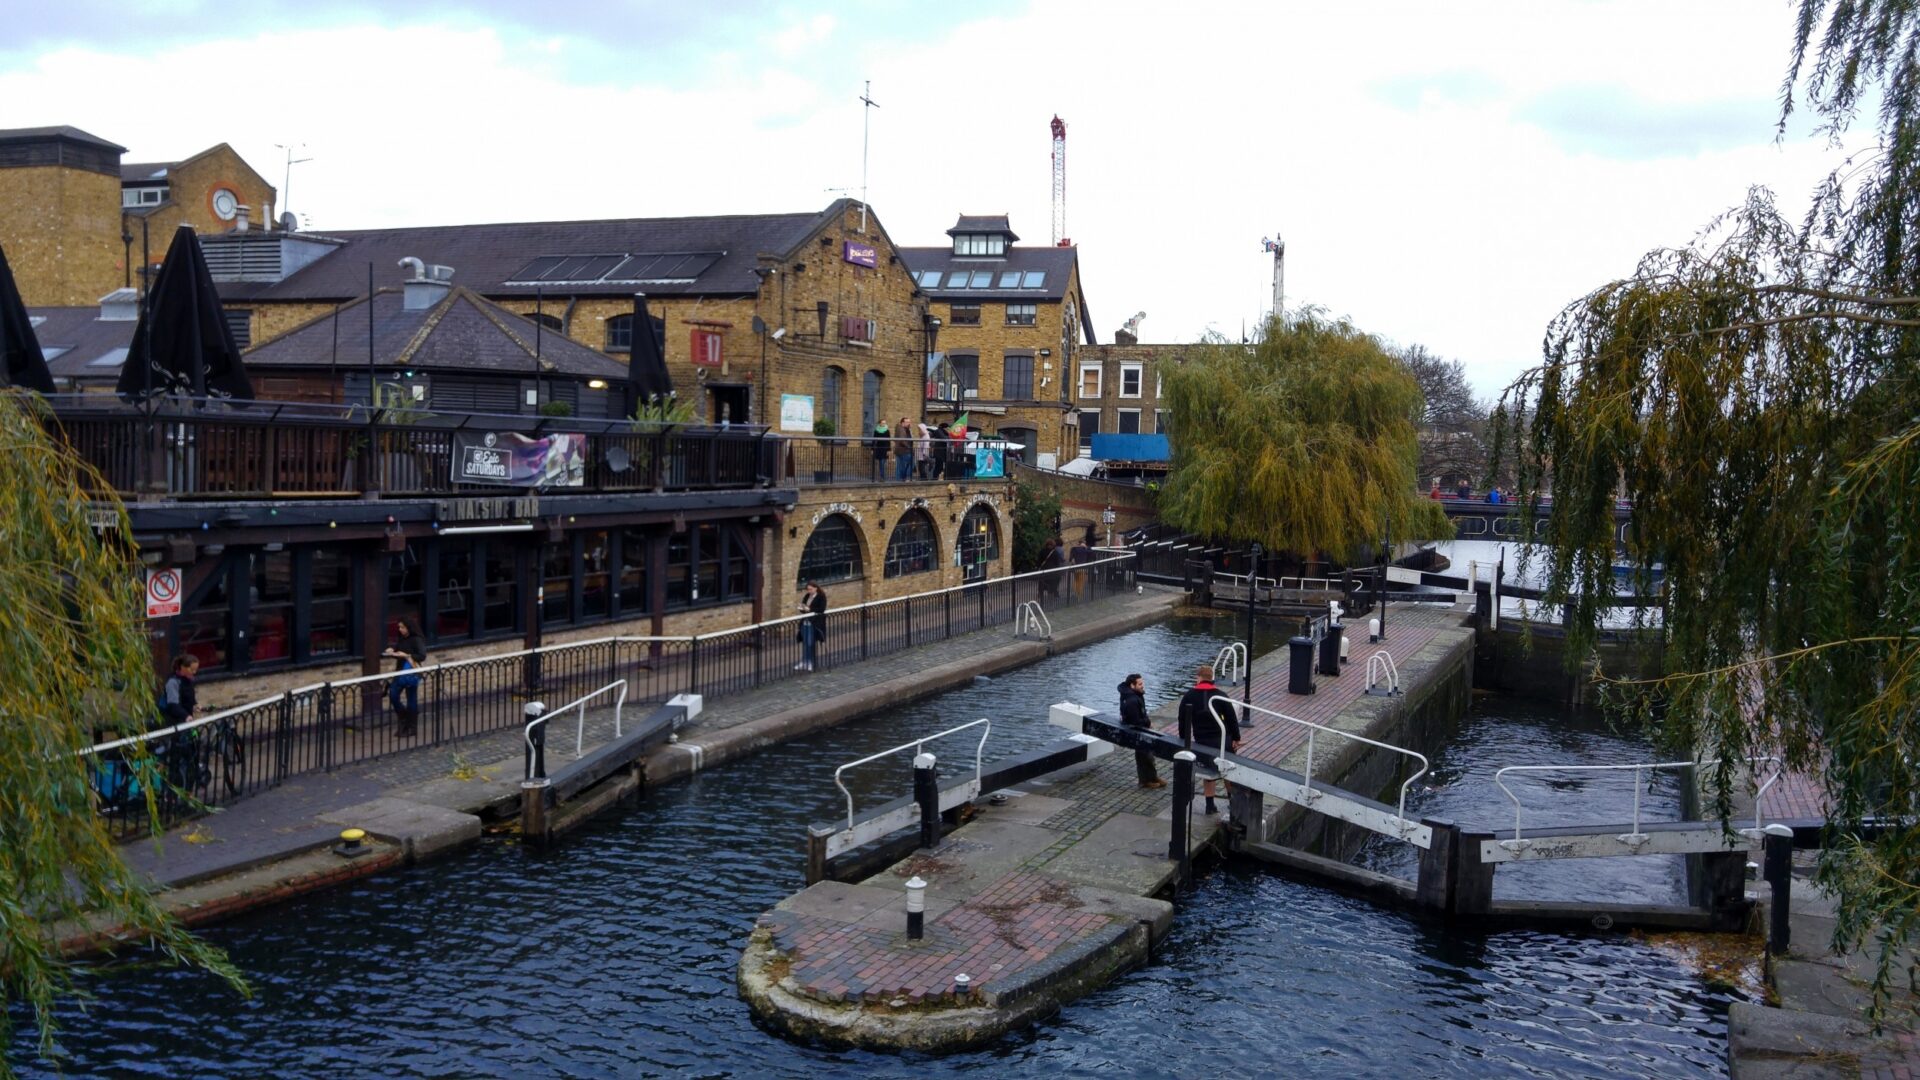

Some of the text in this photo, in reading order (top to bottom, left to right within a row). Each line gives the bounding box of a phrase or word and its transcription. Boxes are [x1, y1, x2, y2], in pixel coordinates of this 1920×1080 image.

[466, 462, 506, 477] SATURDAYS
[438, 497, 539, 521] CANALSIDE BAR
[812, 502, 863, 525] CAMDEN
